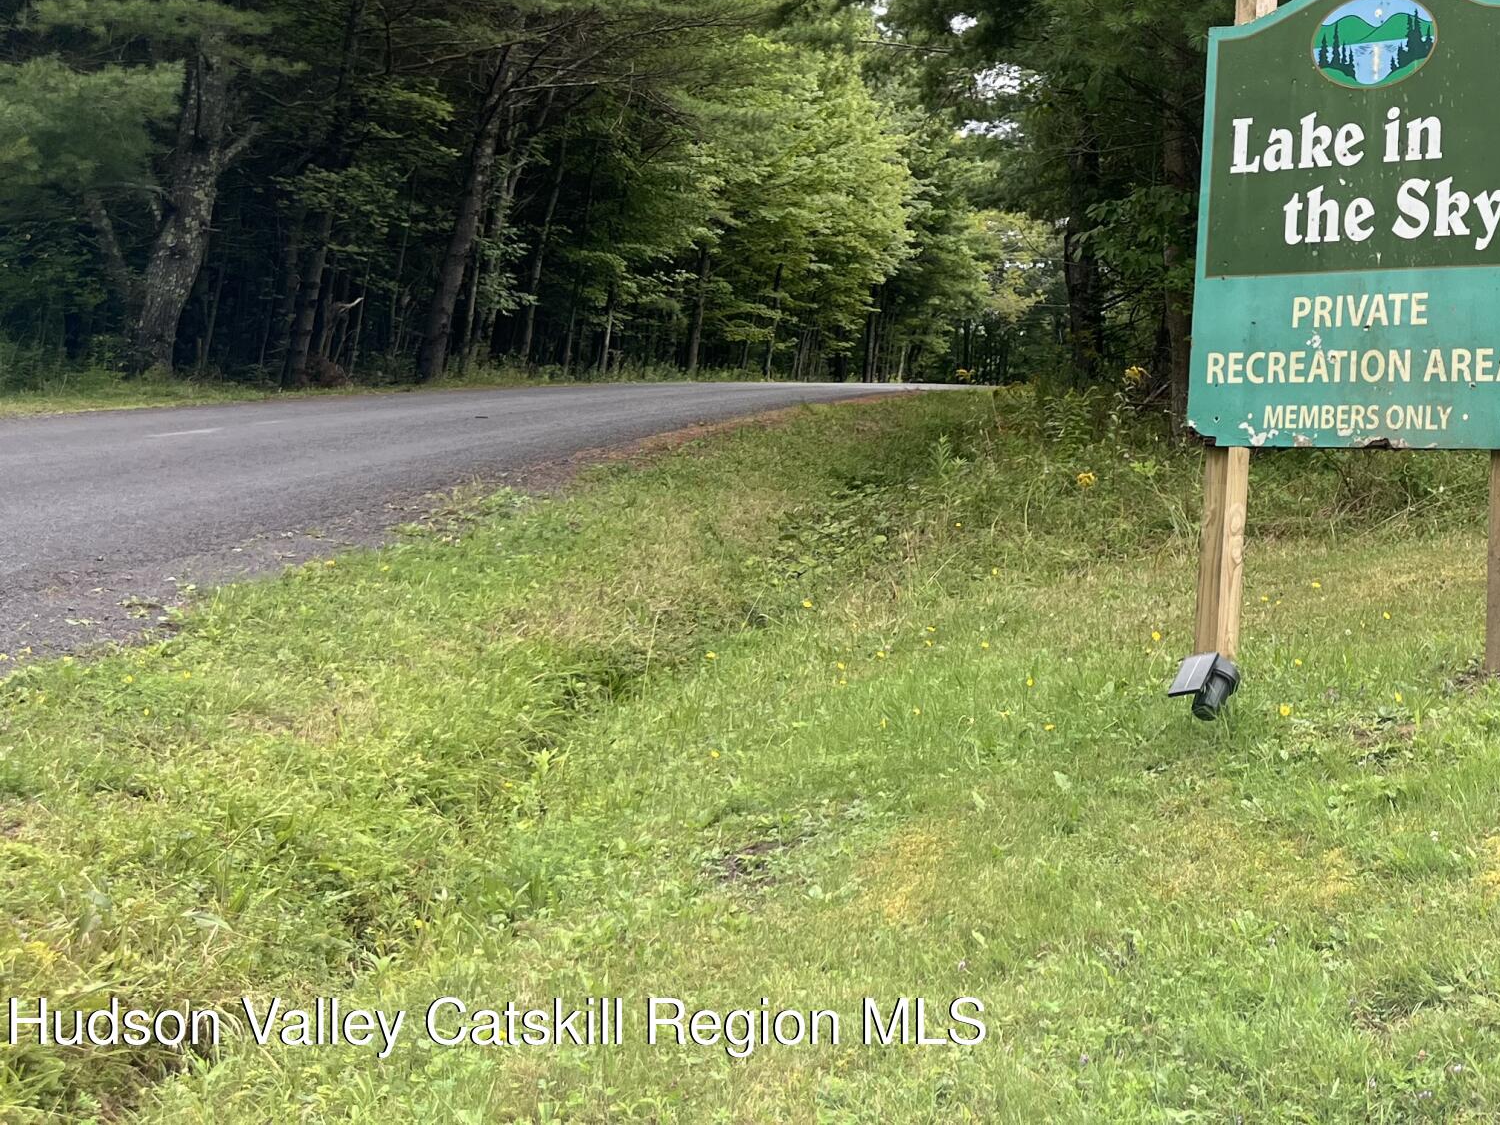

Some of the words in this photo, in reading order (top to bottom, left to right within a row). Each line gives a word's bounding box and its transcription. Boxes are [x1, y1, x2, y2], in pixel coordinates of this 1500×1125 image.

[1230, 112, 1365, 174] Lake
[1383, 106, 1443, 163] in
[1283, 185, 1375, 245] the
[1291, 292, 1429, 328] PRIVATE
[1206, 349, 1411, 384] RECREATION
[1263, 405, 1379, 430] MEMBERS
[1386, 405, 1453, 430] ONLY
